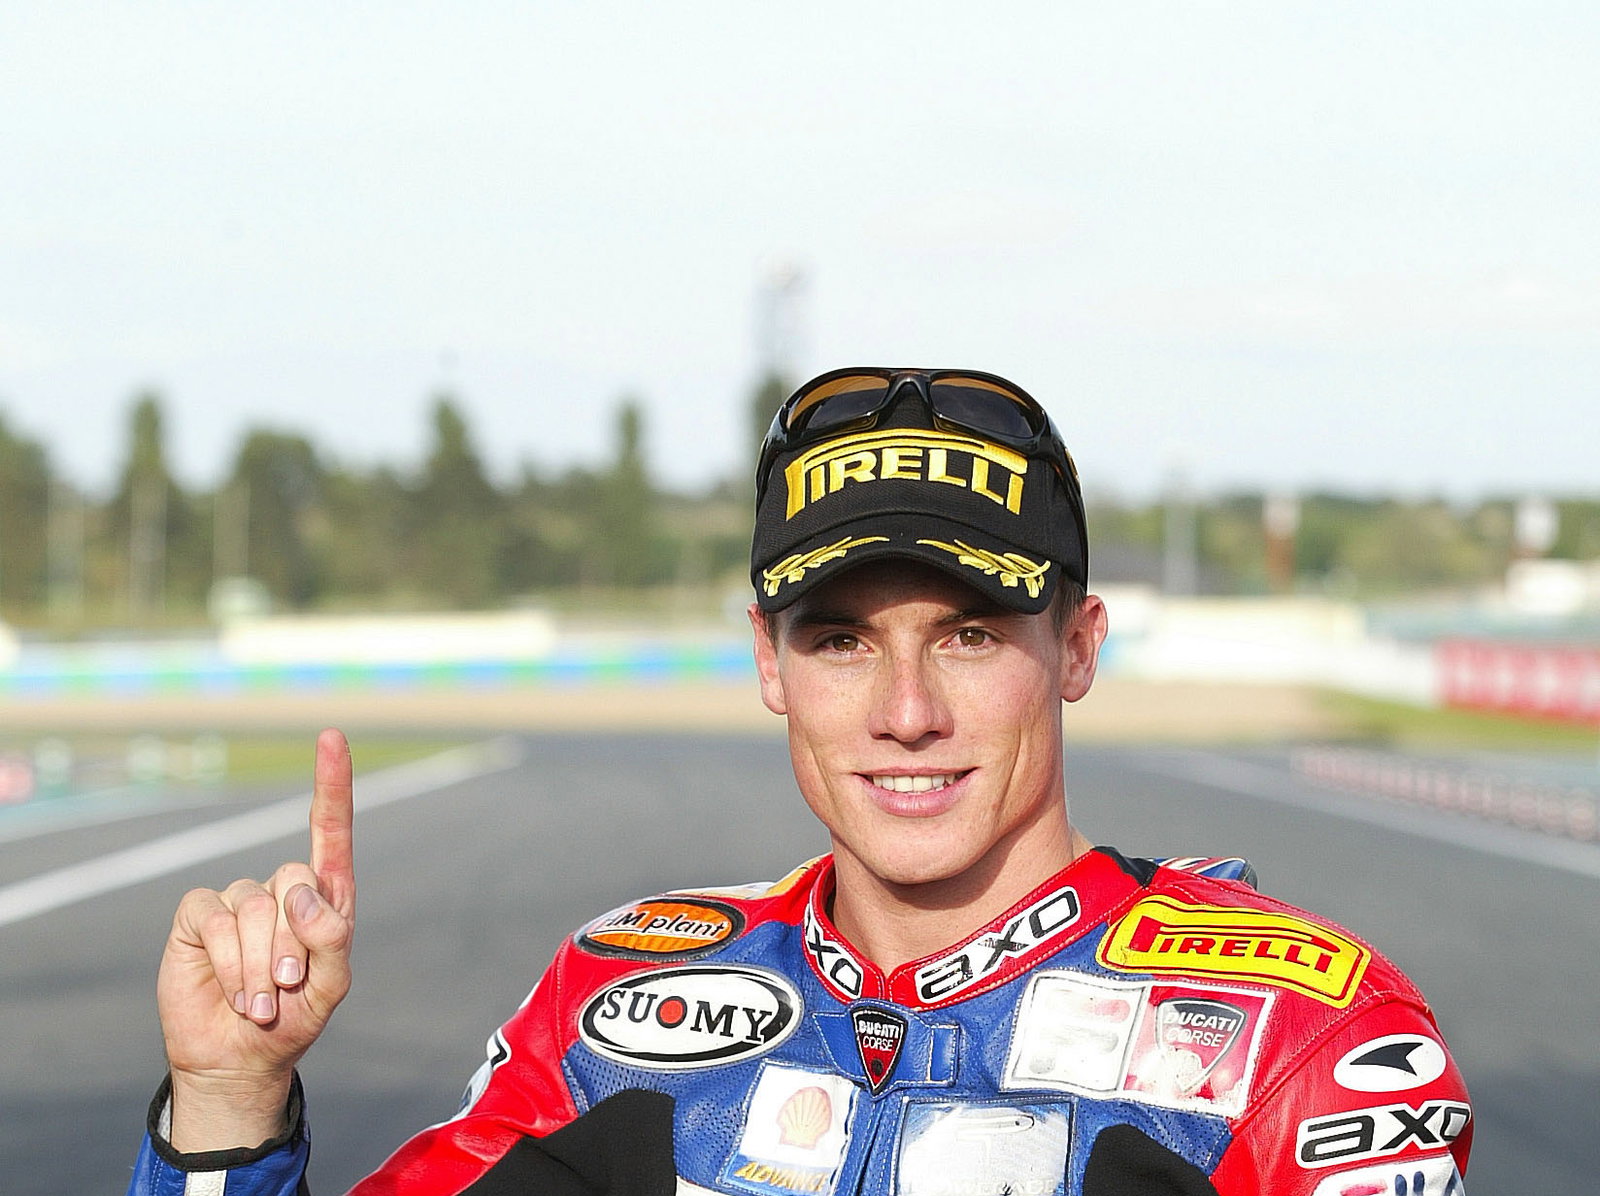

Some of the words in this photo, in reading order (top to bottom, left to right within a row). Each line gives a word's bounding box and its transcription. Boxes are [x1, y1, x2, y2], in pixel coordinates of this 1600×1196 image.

[784, 428, 1028, 521] PIRELLI
[642, 914, 724, 937] plant
[1129, 915, 1341, 974] PIRELLI
[601, 990, 772, 1042] SUOMY
[1163, 1011, 1237, 1032] DUCATI
[858, 1021, 899, 1039] DUCATI
[1165, 1028, 1226, 1048] CORSE
[862, 1035, 894, 1051] CORSE
